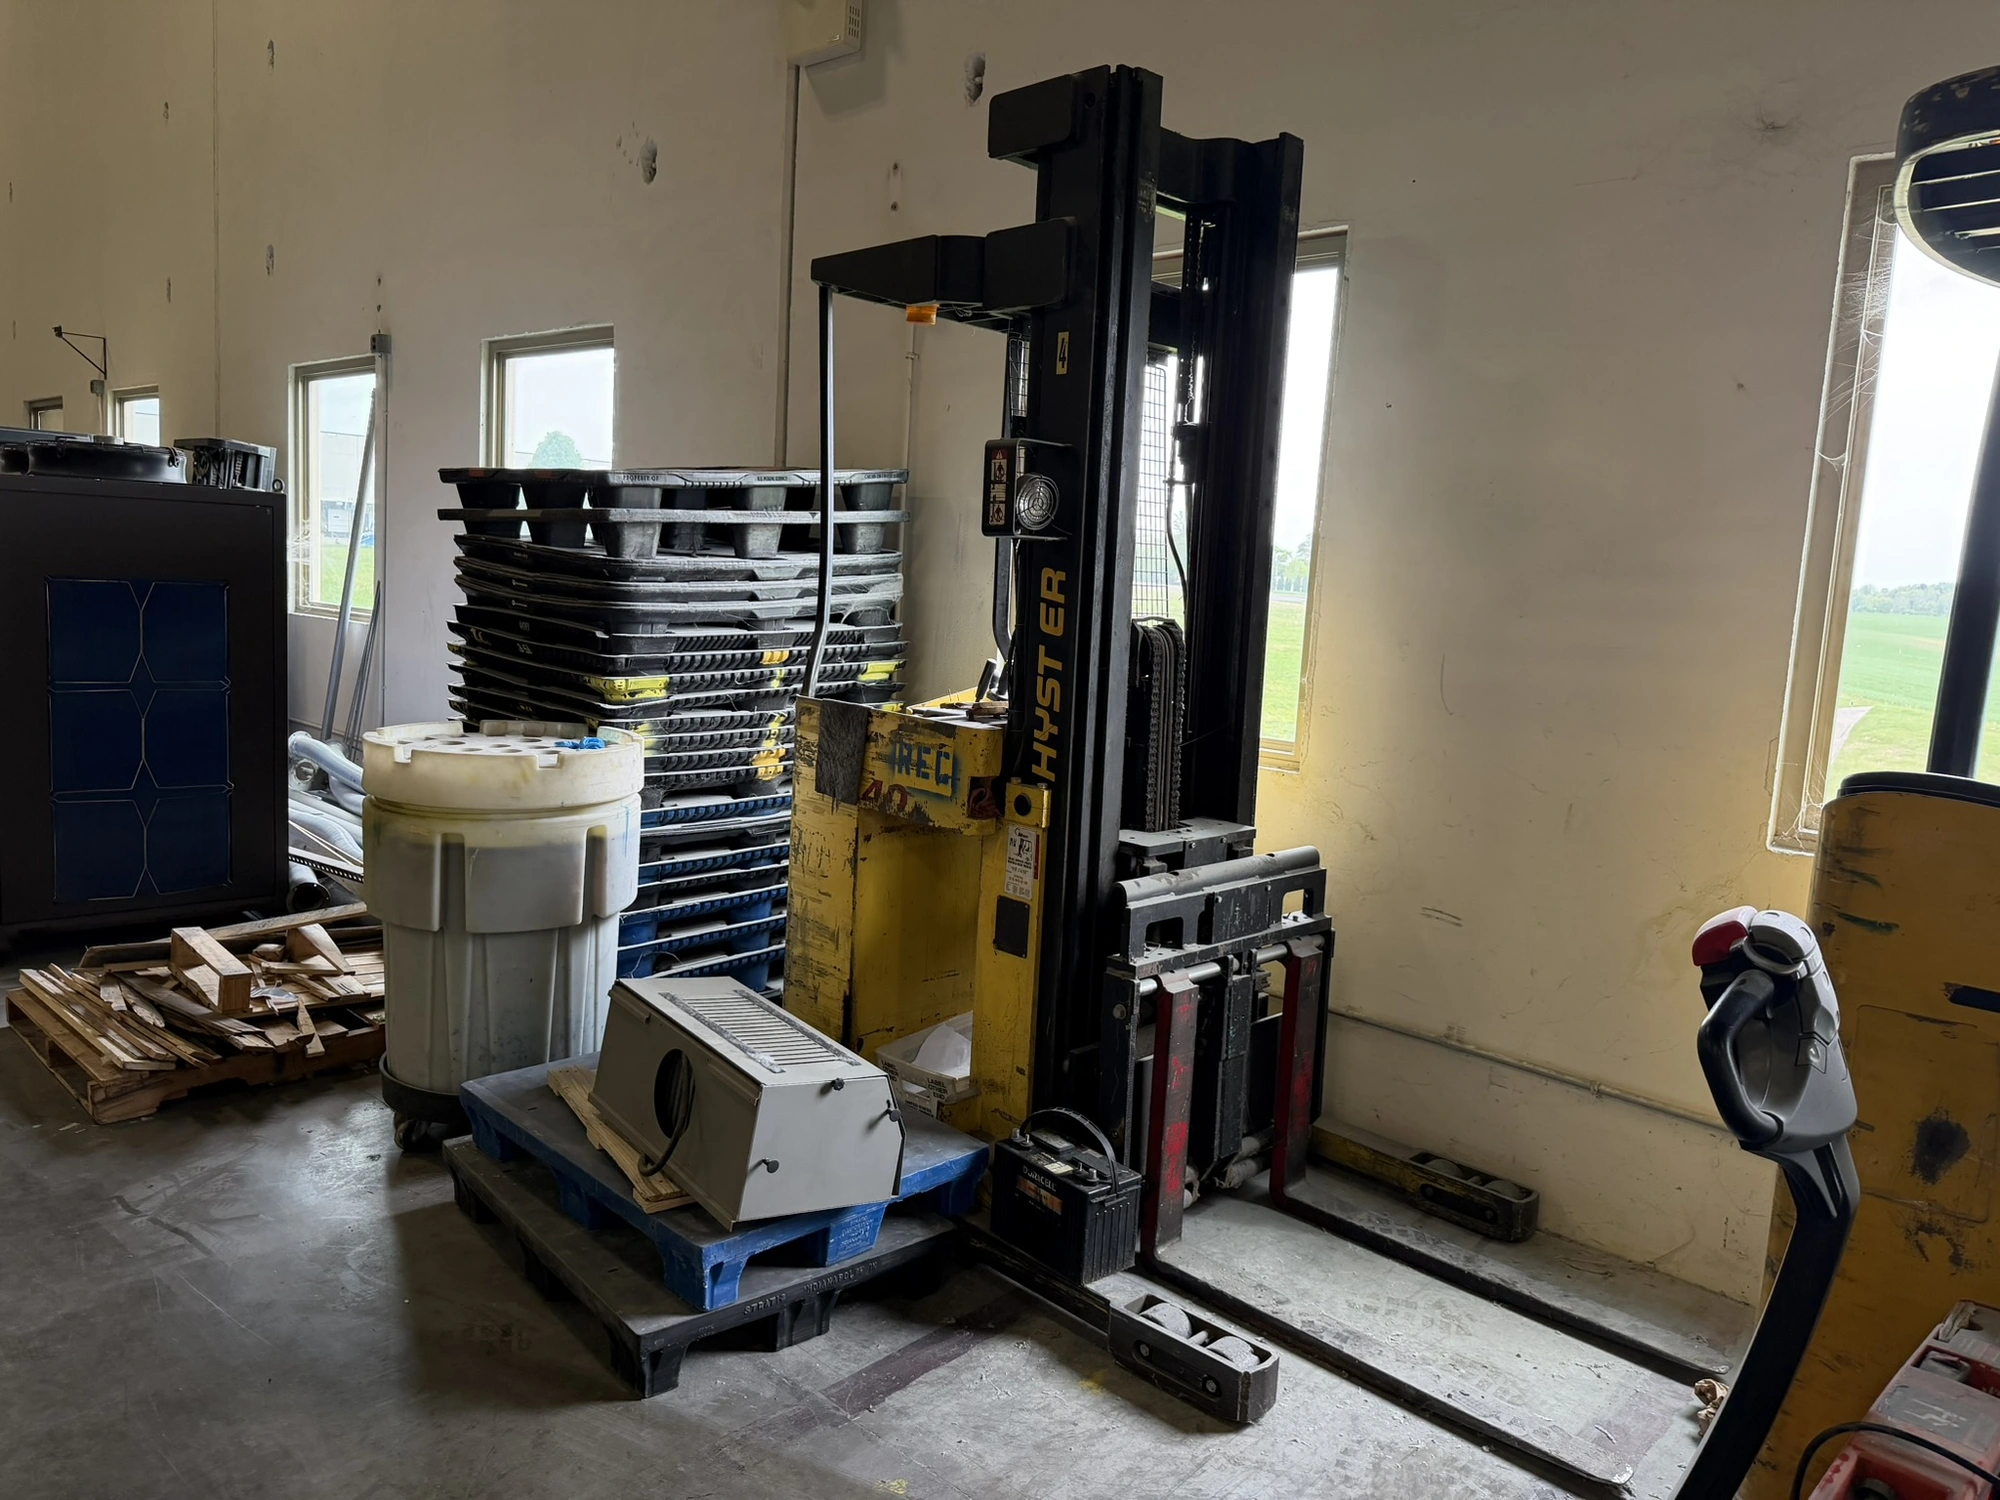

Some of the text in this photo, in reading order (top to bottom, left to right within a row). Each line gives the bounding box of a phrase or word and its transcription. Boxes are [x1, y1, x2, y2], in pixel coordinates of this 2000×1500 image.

[1057, 343, 1067, 370] 4
[897, 741, 951, 786] REC
[881, 1059, 898, 1071] LABEL
[882, 1065, 899, 1077] OTHER
[927, 1078, 947, 1088] LABEL
[928, 1084, 948, 1095] OTHER
[933, 1092, 945, 1100] END
[1022, 1165, 1057, 1192] DURACELL
